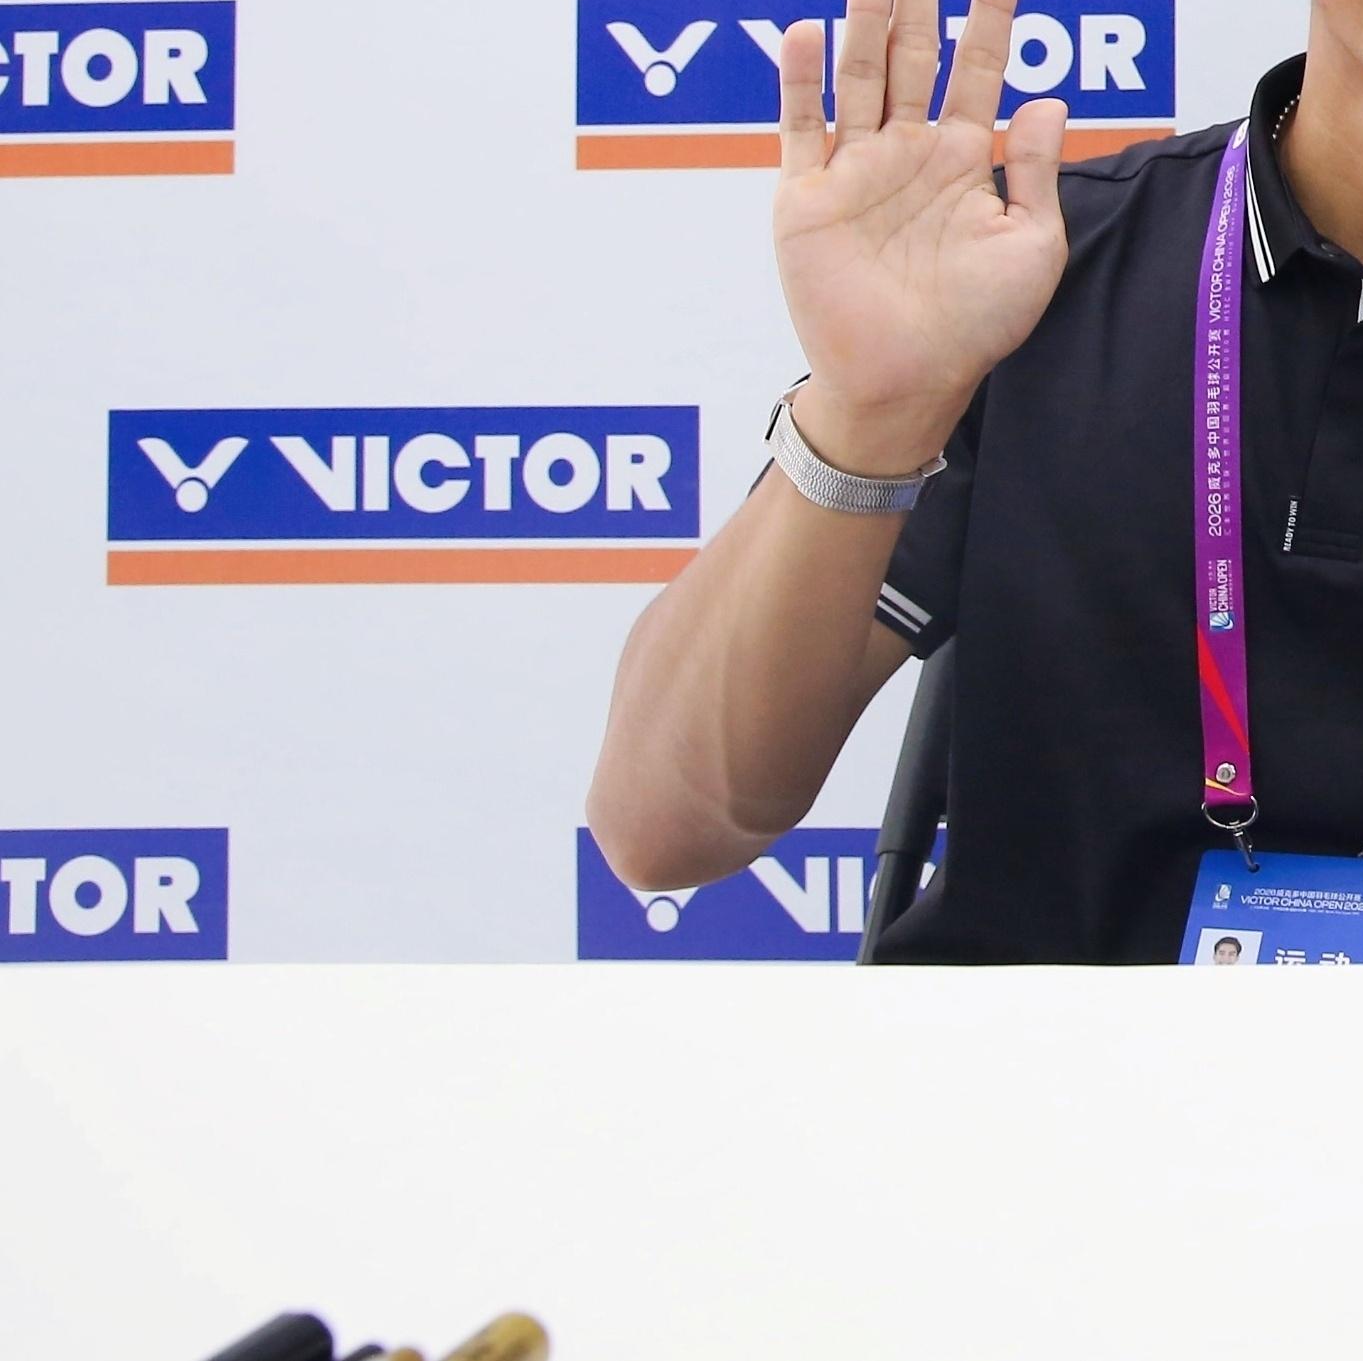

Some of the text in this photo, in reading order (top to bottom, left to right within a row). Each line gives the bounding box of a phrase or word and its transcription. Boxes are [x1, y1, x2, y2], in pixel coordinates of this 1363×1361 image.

[0, 27, 208, 108] TOR
[1217, 200, 1232, 232] OPEN
[1212, 232, 1227, 271] CHINA
[1209, 272, 1223, 323] VICTOR
[271, 433, 671, 513] VICTOR
[1283, 500, 1298, 552] READY TO WIN
[1208, 588, 1218, 612] VICTOR
[1216, 560, 1229, 612] CHINA OPEN
[1241, 895, 1279, 906] VICTOR
[1280, 898, 1313, 908] CHINA
[1314, 900, 1343, 910] OPEN
